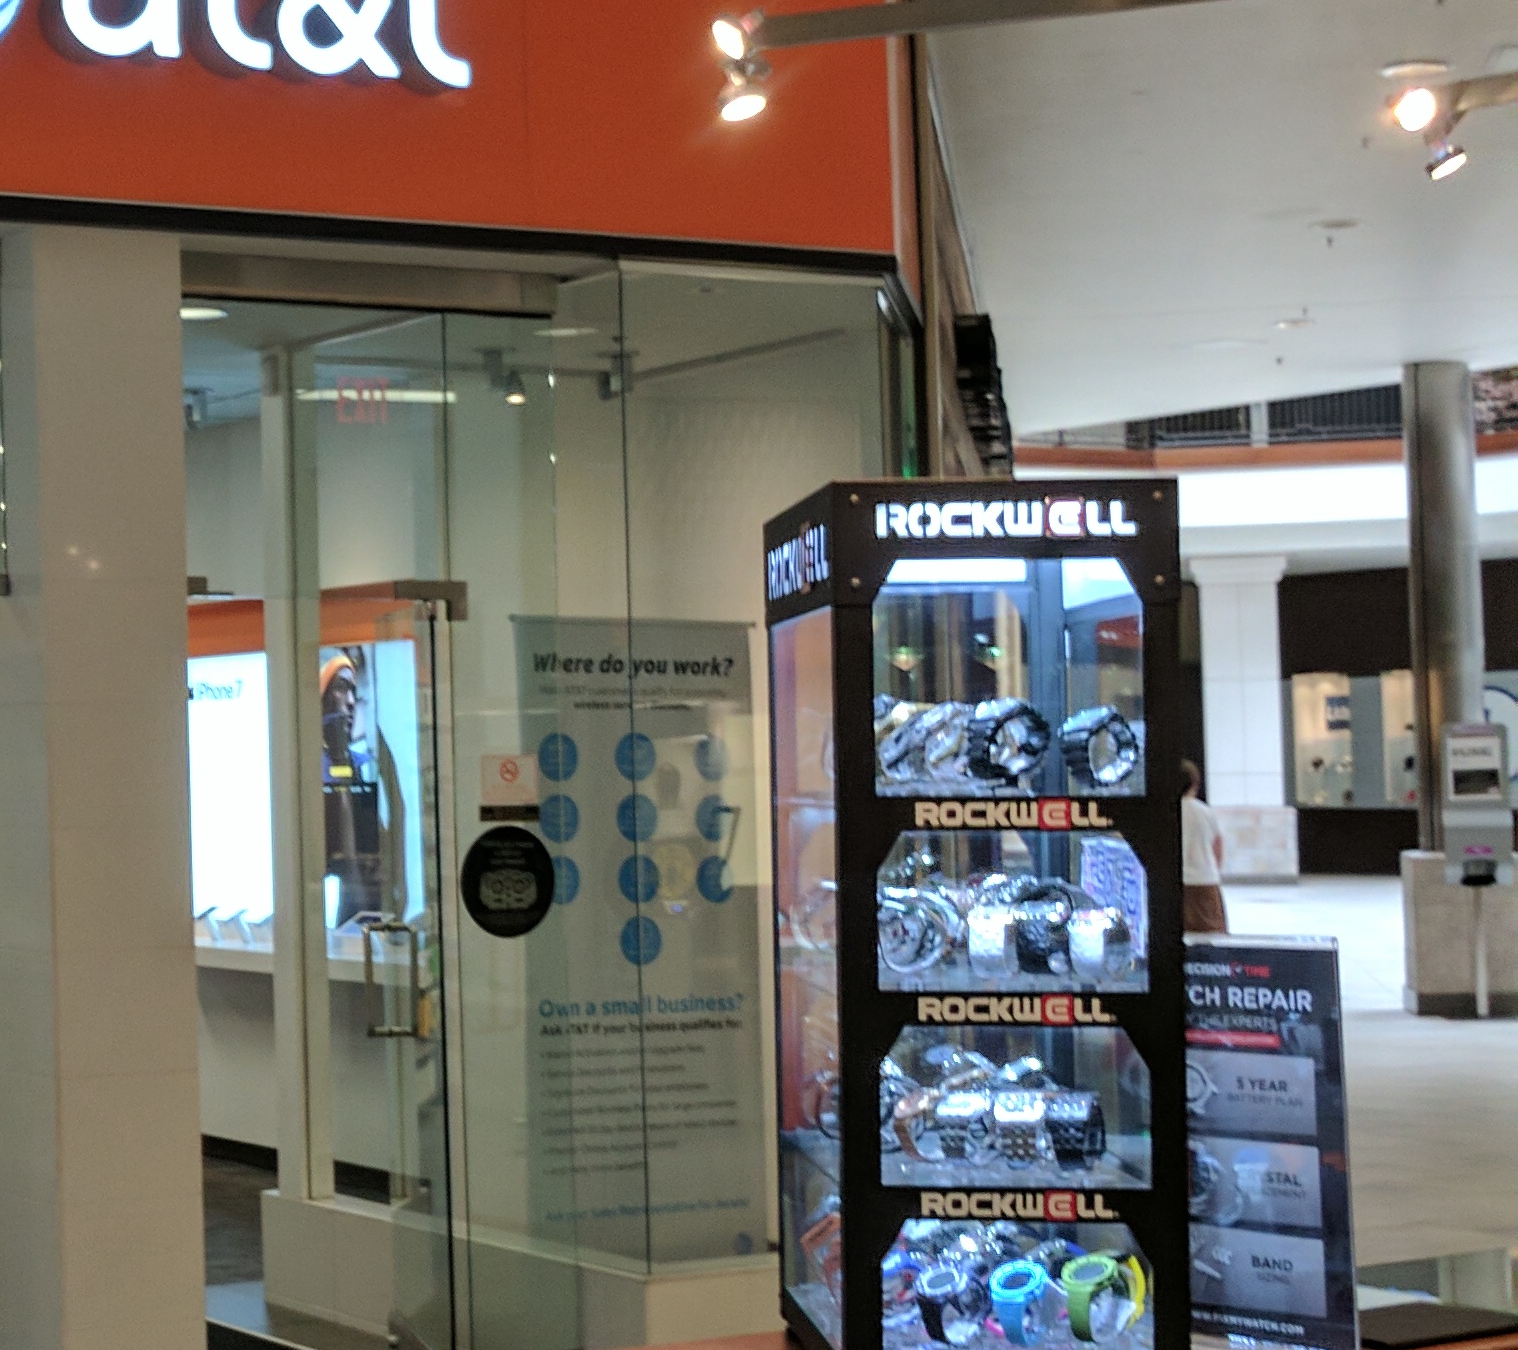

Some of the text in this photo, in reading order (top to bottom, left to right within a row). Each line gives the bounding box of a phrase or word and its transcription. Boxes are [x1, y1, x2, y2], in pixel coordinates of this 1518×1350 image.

[337, 376, 388, 423] EXIT
[875, 497, 1138, 539] ROCKWELL
[534, 652, 734, 678] Where do you work?
[915, 799, 1109, 829] ROCKWELL
[586, 1002, 596, 1015] a
[918, 994, 1112, 1024] ROCKWELL
[1186, 984, 1313, 1012] CH REPAIR
[920, 1191, 1114, 1219] ROCKWELL
[1251, 1254, 1294, 1272] BAND
